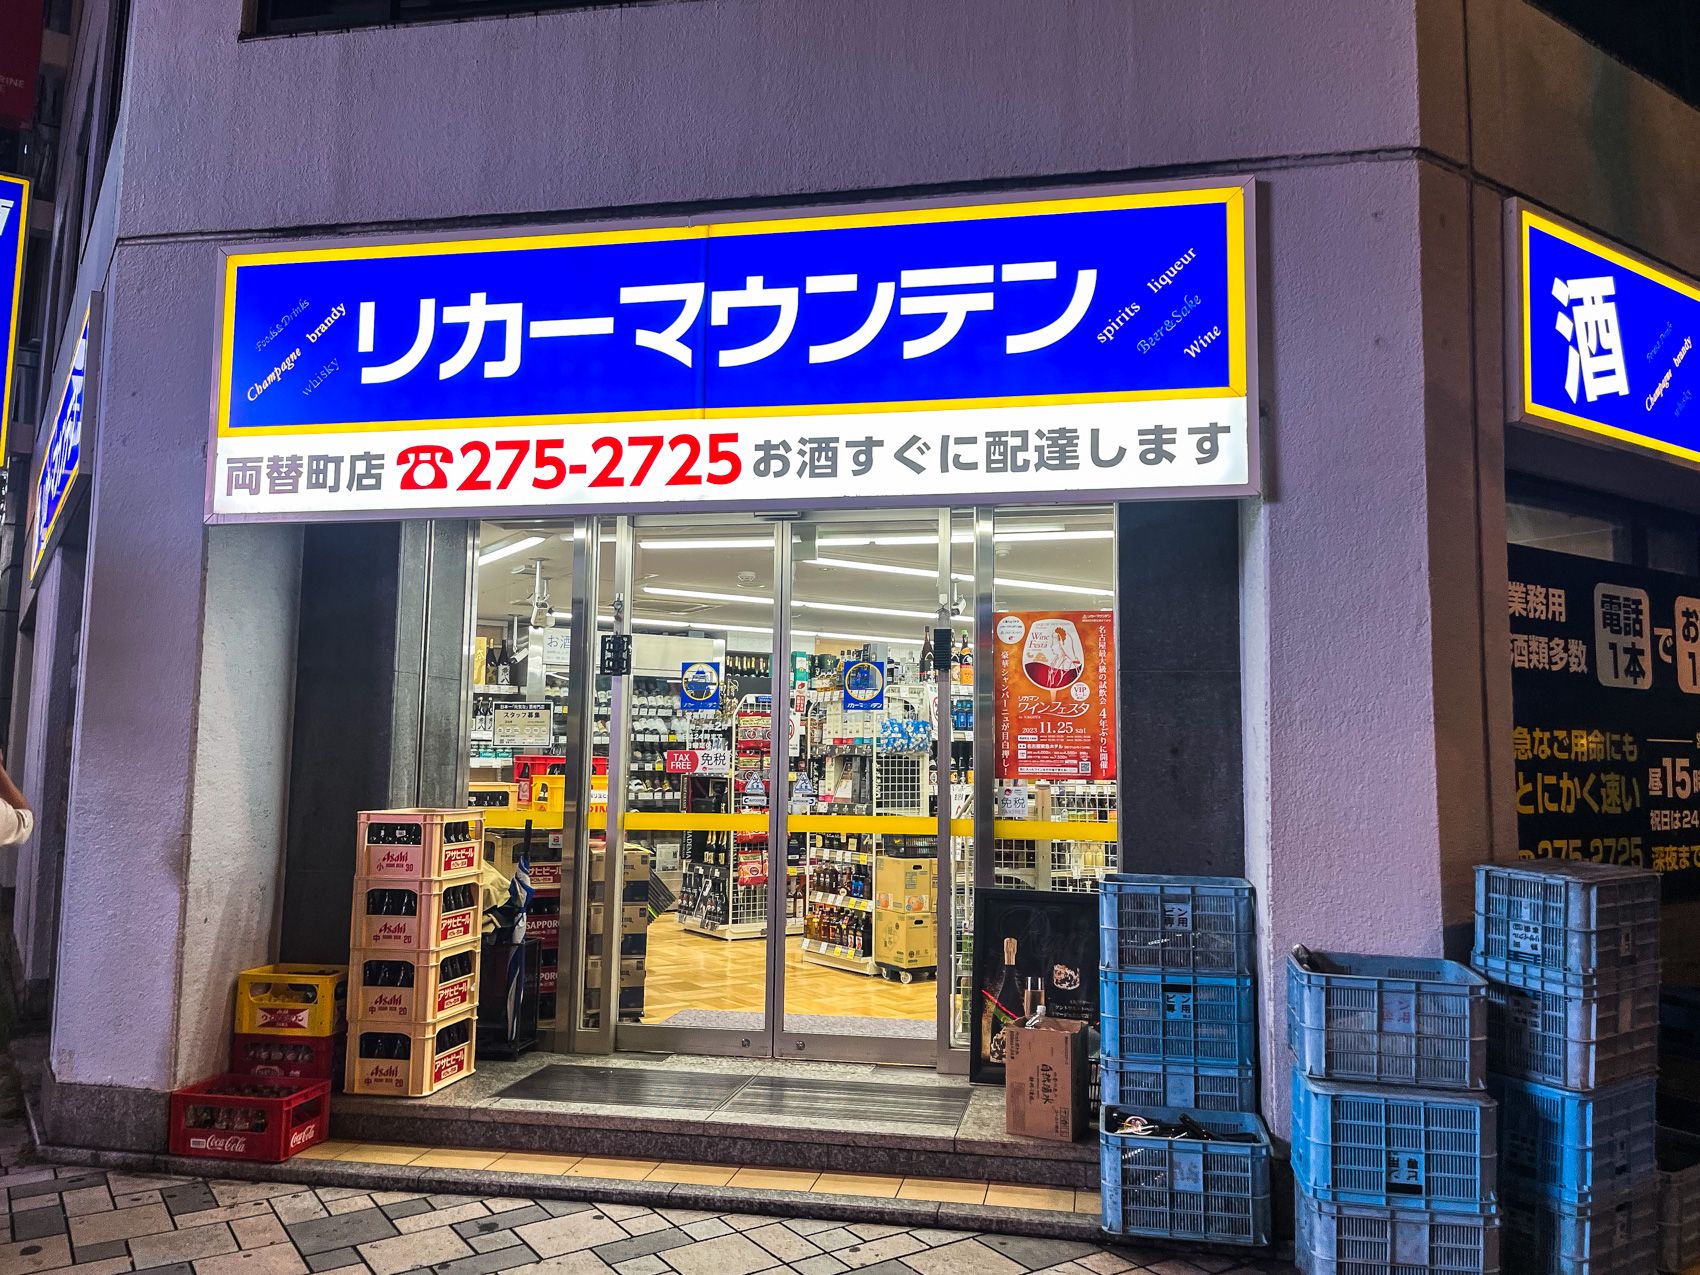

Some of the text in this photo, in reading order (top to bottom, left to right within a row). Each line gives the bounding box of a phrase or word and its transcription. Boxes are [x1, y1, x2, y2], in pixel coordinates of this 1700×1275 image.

[1147, 248, 1197, 293] liqueur
[306, 303, 346, 343] brandy
[358, 261, 1098, 384] リカーマウンテン
[1097, 302, 1140, 343] spirits
[1137, 295, 1201, 354] Beer&Sake
[1184, 326, 1221, 358] Wine
[1552, 276, 1629, 404] 酒
[247, 348, 302, 401] Champagne
[302, 358, 340, 396] whisky
[226, 422, 1231, 496] 両替町店 275-2725 お酒すぐに配達します
[1507, 581, 1566, 622] 業務用
[1601, 593, 1644, 638] 電話
[1510, 632, 1588, 674] 酒類多数
[1018, 702, 1090, 715] ワインフェスタ
[1040, 722, 1073, 733] 11.25
[673, 753, 690, 761] TAX
[701, 752, 726, 766] 免税
[671, 762, 692, 770] FREE
[1516, 771, 1641, 815] とにかく速い
[1001, 797, 1026, 809] 免税
[382, 851, 408, 862] Asahi
[445, 848, 473, 861] アサヒビール
[406, 864, 413, 872] 30
[1165, 907, 1188, 917] ビン
[379, 923, 406, 934] Asahi
[441, 914, 470, 931] アサヒビール
[526, 920, 560, 929] SAPPOR
[374, 994, 402, 1005] Asahi
[438, 983, 467, 1001] アサヒビール
[1167, 994, 1190, 1003] ビン
[399, 1007, 407, 1015] 20
[435, 1050, 464, 1072] アサヒビール
[370, 1065, 398, 1077] Asahi
[395, 1079, 403, 1087] 20
